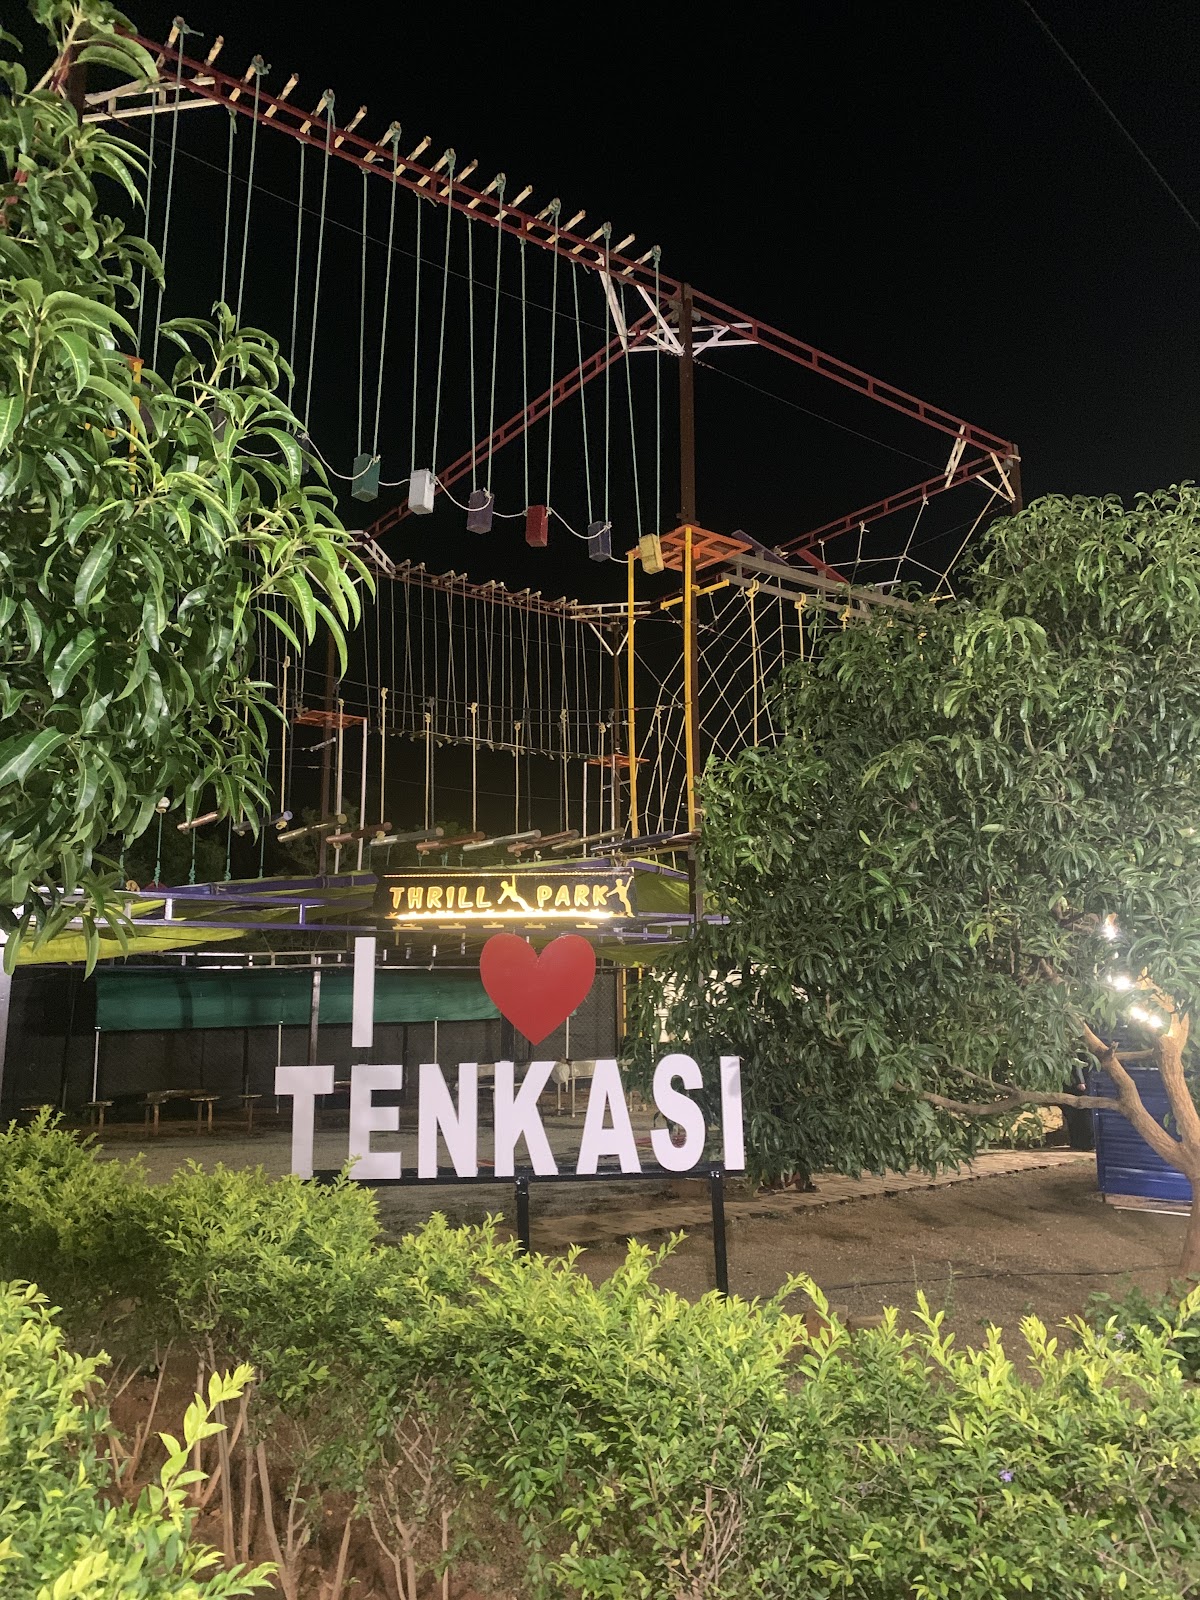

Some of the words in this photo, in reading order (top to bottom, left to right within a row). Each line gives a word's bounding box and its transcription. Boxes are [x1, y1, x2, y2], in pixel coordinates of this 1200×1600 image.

[389, 886, 491, 909] THRILL
[536, 885, 609, 907] PARK
[352, 937, 376, 1047] I
[275, 1054, 746, 1180] TENKASI
